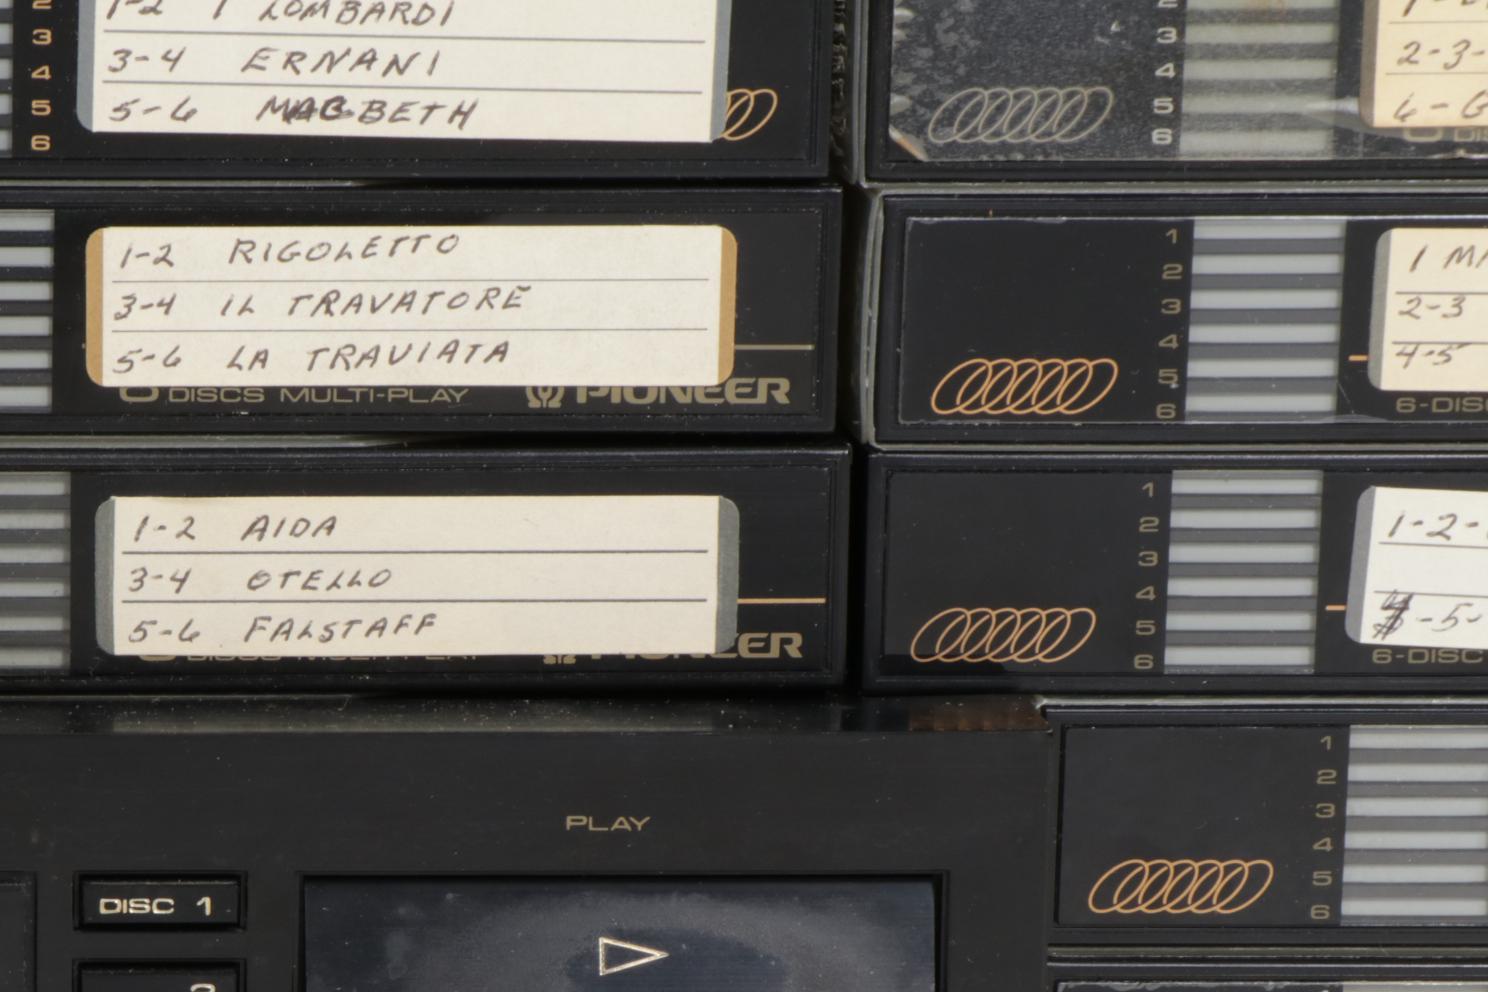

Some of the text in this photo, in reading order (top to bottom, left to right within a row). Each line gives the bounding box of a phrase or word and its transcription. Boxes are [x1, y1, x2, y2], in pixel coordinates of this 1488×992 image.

[258, 0, 455, 27] LOMBARDI
[32, 28, 52, 46] 3
[1156, 26, 1178, 44] 3
[108, 47, 440, 78] 3-4 ERNANI
[1154, 62, 1176, 79] 4
[31, 65, 52, 80] 4
[31, 99, 52, 116] 5
[109, 96, 198, 123] 5-6
[1152, 97, 1174, 115] 5
[30, 134, 51, 151] 6
[1151, 128, 1173, 145] 6
[1165, 228, 1178, 244] 1
[119, 233, 460, 269] 1-2 RIGOLETTO
[1161, 263, 1183, 280] 2
[113, 285, 532, 321] 3-4 IL TRAVATORE
[1161, 298, 1182, 315] 3
[1398, 296, 1466, 320] 2-3
[1158, 333, 1179, 350] 4
[112, 338, 510, 374] 5-6 LA TRAVIATA
[1395, 342, 1473, 369] 4-5
[1159, 369, 1178, 385] 5
[168, 387, 264, 402] DISCS
[279, 387, 469, 403] MULTI-PLAY
[1155, 403, 1177, 420] 6
[1395, 396, 1488, 413] 6-DIS
[1141, 482, 1154, 498] 1
[133, 514, 337, 543] 1-2 AIDA
[1138, 516, 1160, 533] 2
[1137, 550, 1159, 567] 3
[129, 566, 392, 595] 3-4 OTELLO
[1135, 585, 1156, 601] 4
[128, 612, 437, 644] 5-6 FALSTAFF
[1135, 619, 1156, 636] 5
[1133, 654, 1154, 670] 6
[1320, 735, 1332, 751] 1
[1316, 768, 1337, 785] 2
[1315, 802, 1336, 819] 3
[565, 815, 651, 832] PLAY
[1312, 837, 1334, 852] 4
[1312, 870, 1333, 887] 5
[99, 896, 211, 916] DISC 1
[1310, 904, 1330, 920] 6
